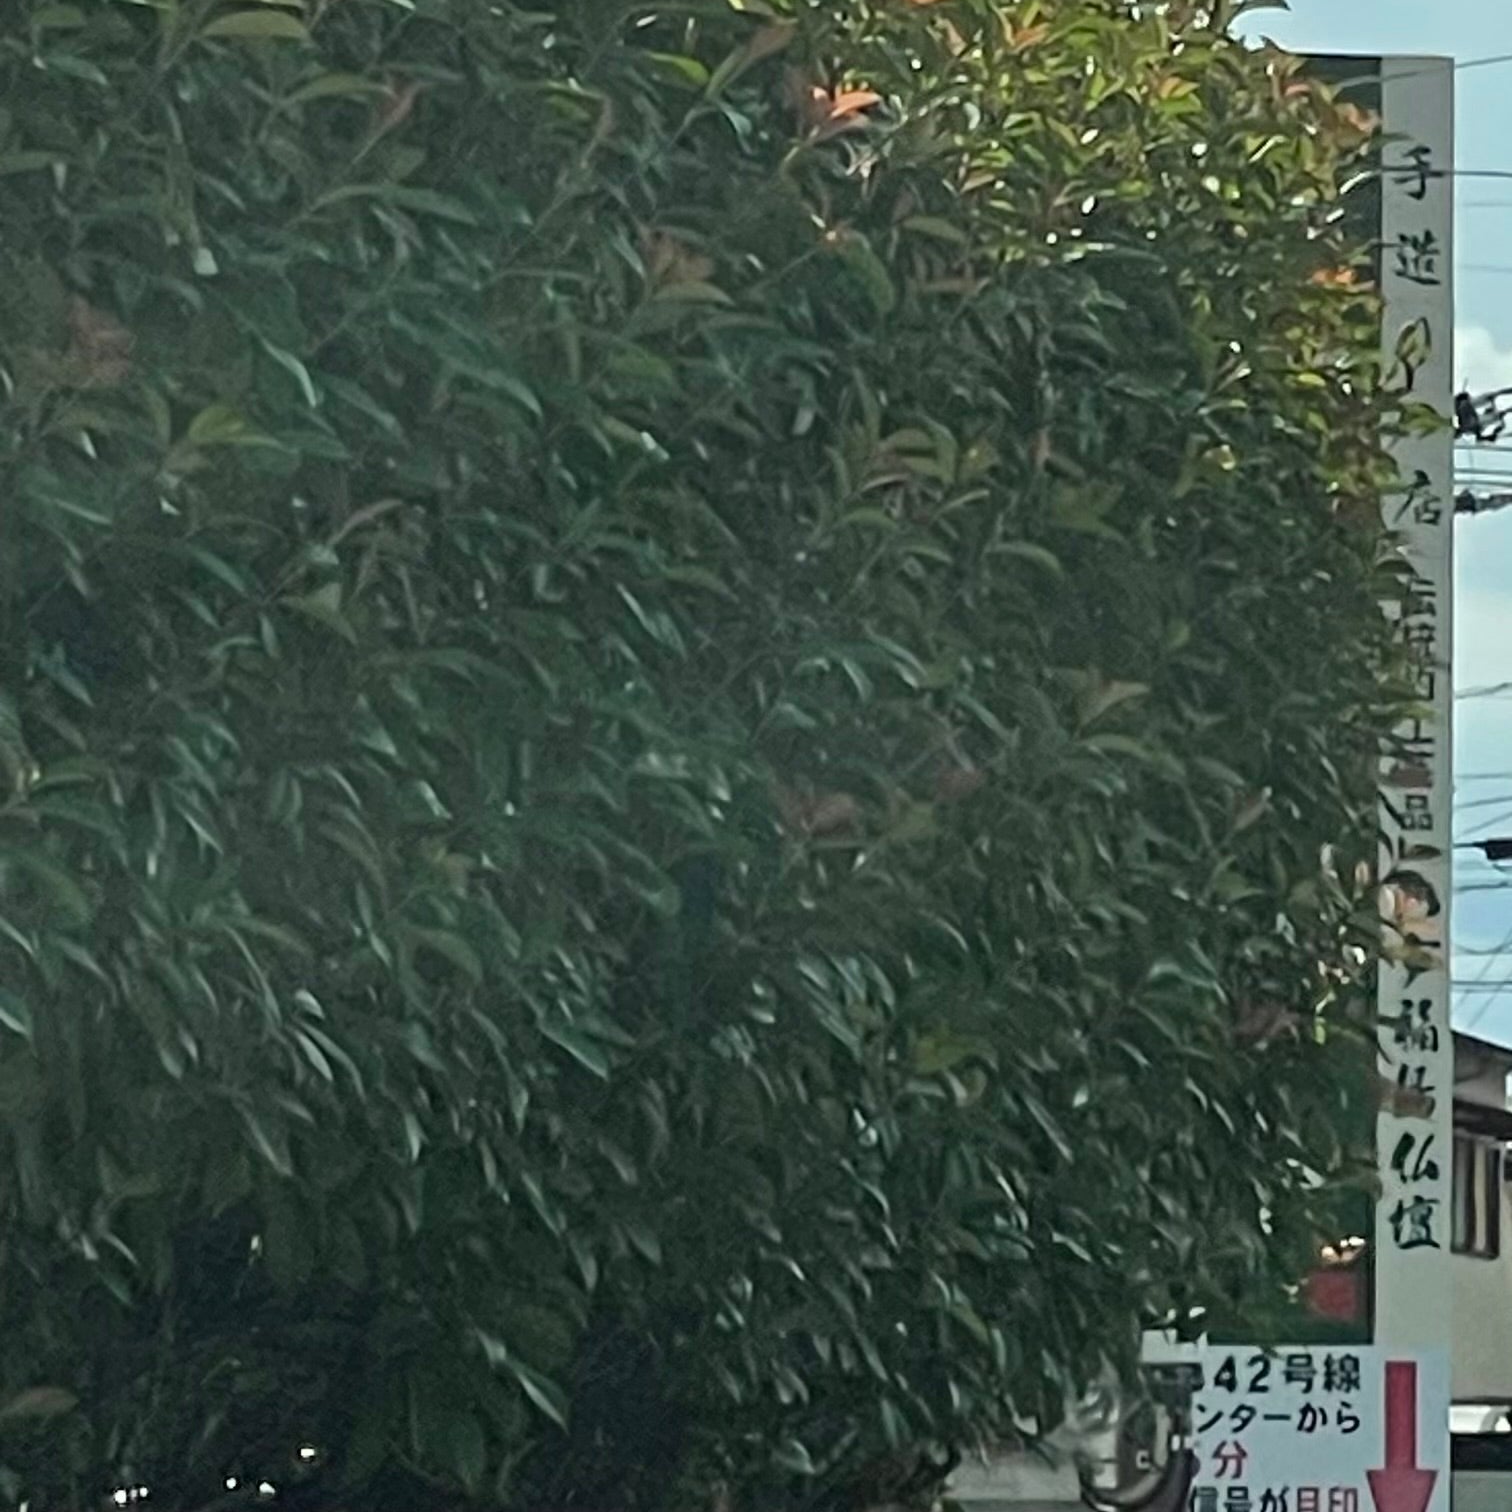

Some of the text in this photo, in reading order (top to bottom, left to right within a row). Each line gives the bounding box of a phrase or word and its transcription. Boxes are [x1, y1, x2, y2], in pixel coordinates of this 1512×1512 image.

[1196, 1401, 1361, 1433] ンターから
[1212, 1441, 1247, 1478] 分
